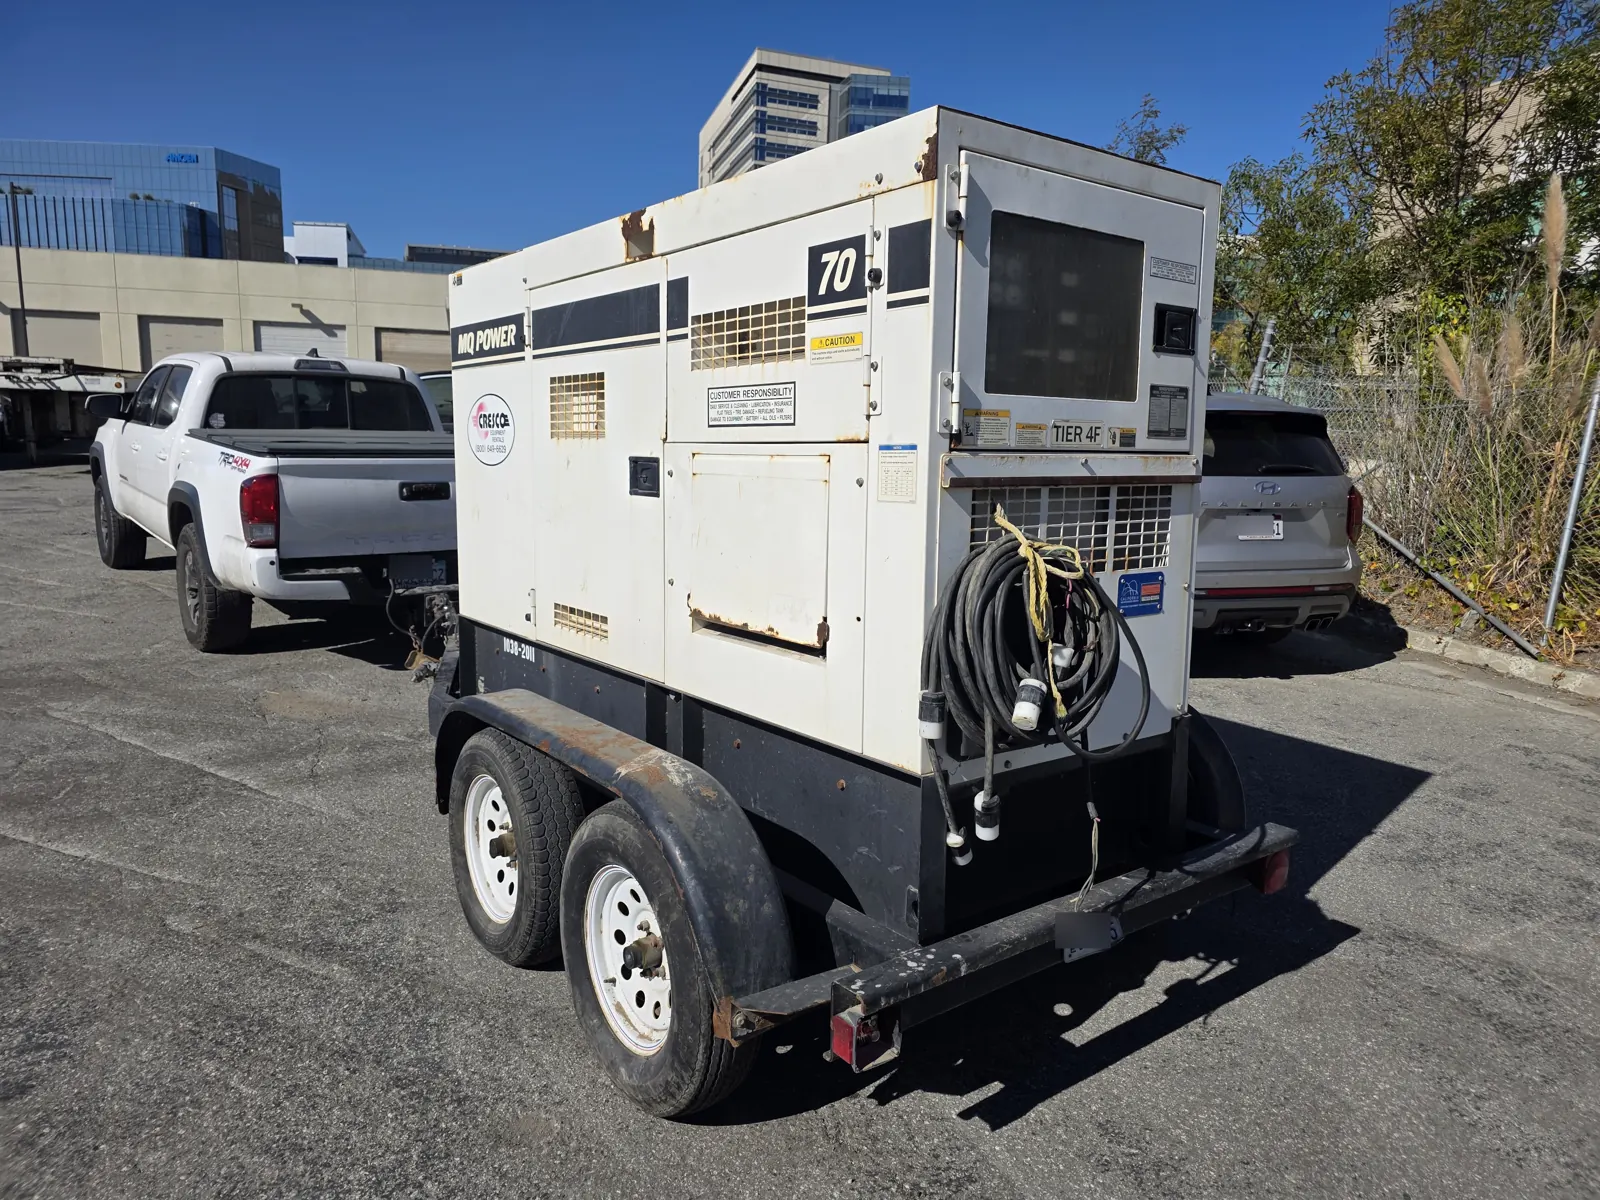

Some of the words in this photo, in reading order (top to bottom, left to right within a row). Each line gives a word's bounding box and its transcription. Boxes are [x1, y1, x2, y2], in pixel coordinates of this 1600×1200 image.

[818, 247, 857, 296] 70
[457, 331, 475, 355] MQ
[475, 323, 517, 352] POWER
[824, 335, 856, 347] CAUTION
[709, 390, 741, 400] CUSTOMER
[742, 387, 793, 399] RESPONSIBILITY
[479, 412, 509, 429] CRESCO
[1053, 425, 1083, 443] TIER
[1085, 425, 1102, 443] 4F
